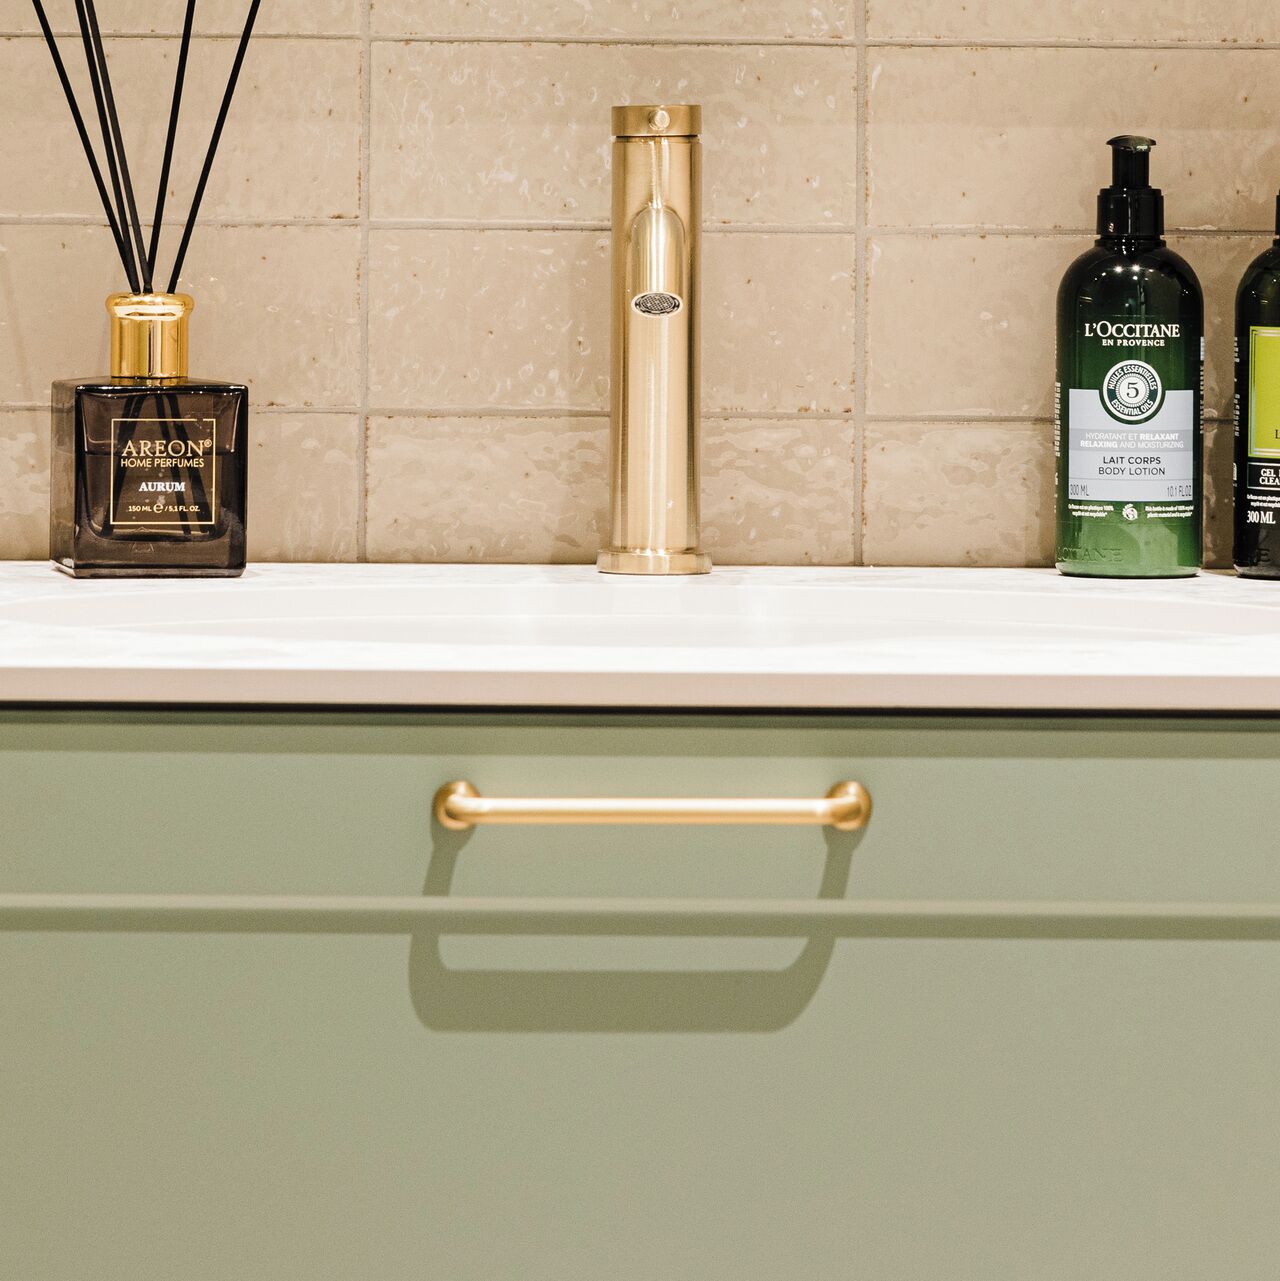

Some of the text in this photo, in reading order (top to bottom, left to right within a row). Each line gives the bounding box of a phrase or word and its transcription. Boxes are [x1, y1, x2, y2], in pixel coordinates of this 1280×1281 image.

[1084, 321, 1180, 338] L'OCCITANE
[1108, 365, 1157, 390] HUILES ESSENTIELLES
[1126, 382, 1139, 398] 5
[1112, 400, 1154, 415] ESSENTIAL OILS
[1086, 432, 1127, 440] HYDRATANT
[121, 459, 204, 467] HOME PERFUMES
[1098, 467, 1126, 475] BODY
[1260, 469, 1276, 477] GEL
[139, 482, 185, 492] AURUM
[1070, 484, 1089, 496] 300 ML
[1247, 511, 1276, 524] 300 ML
